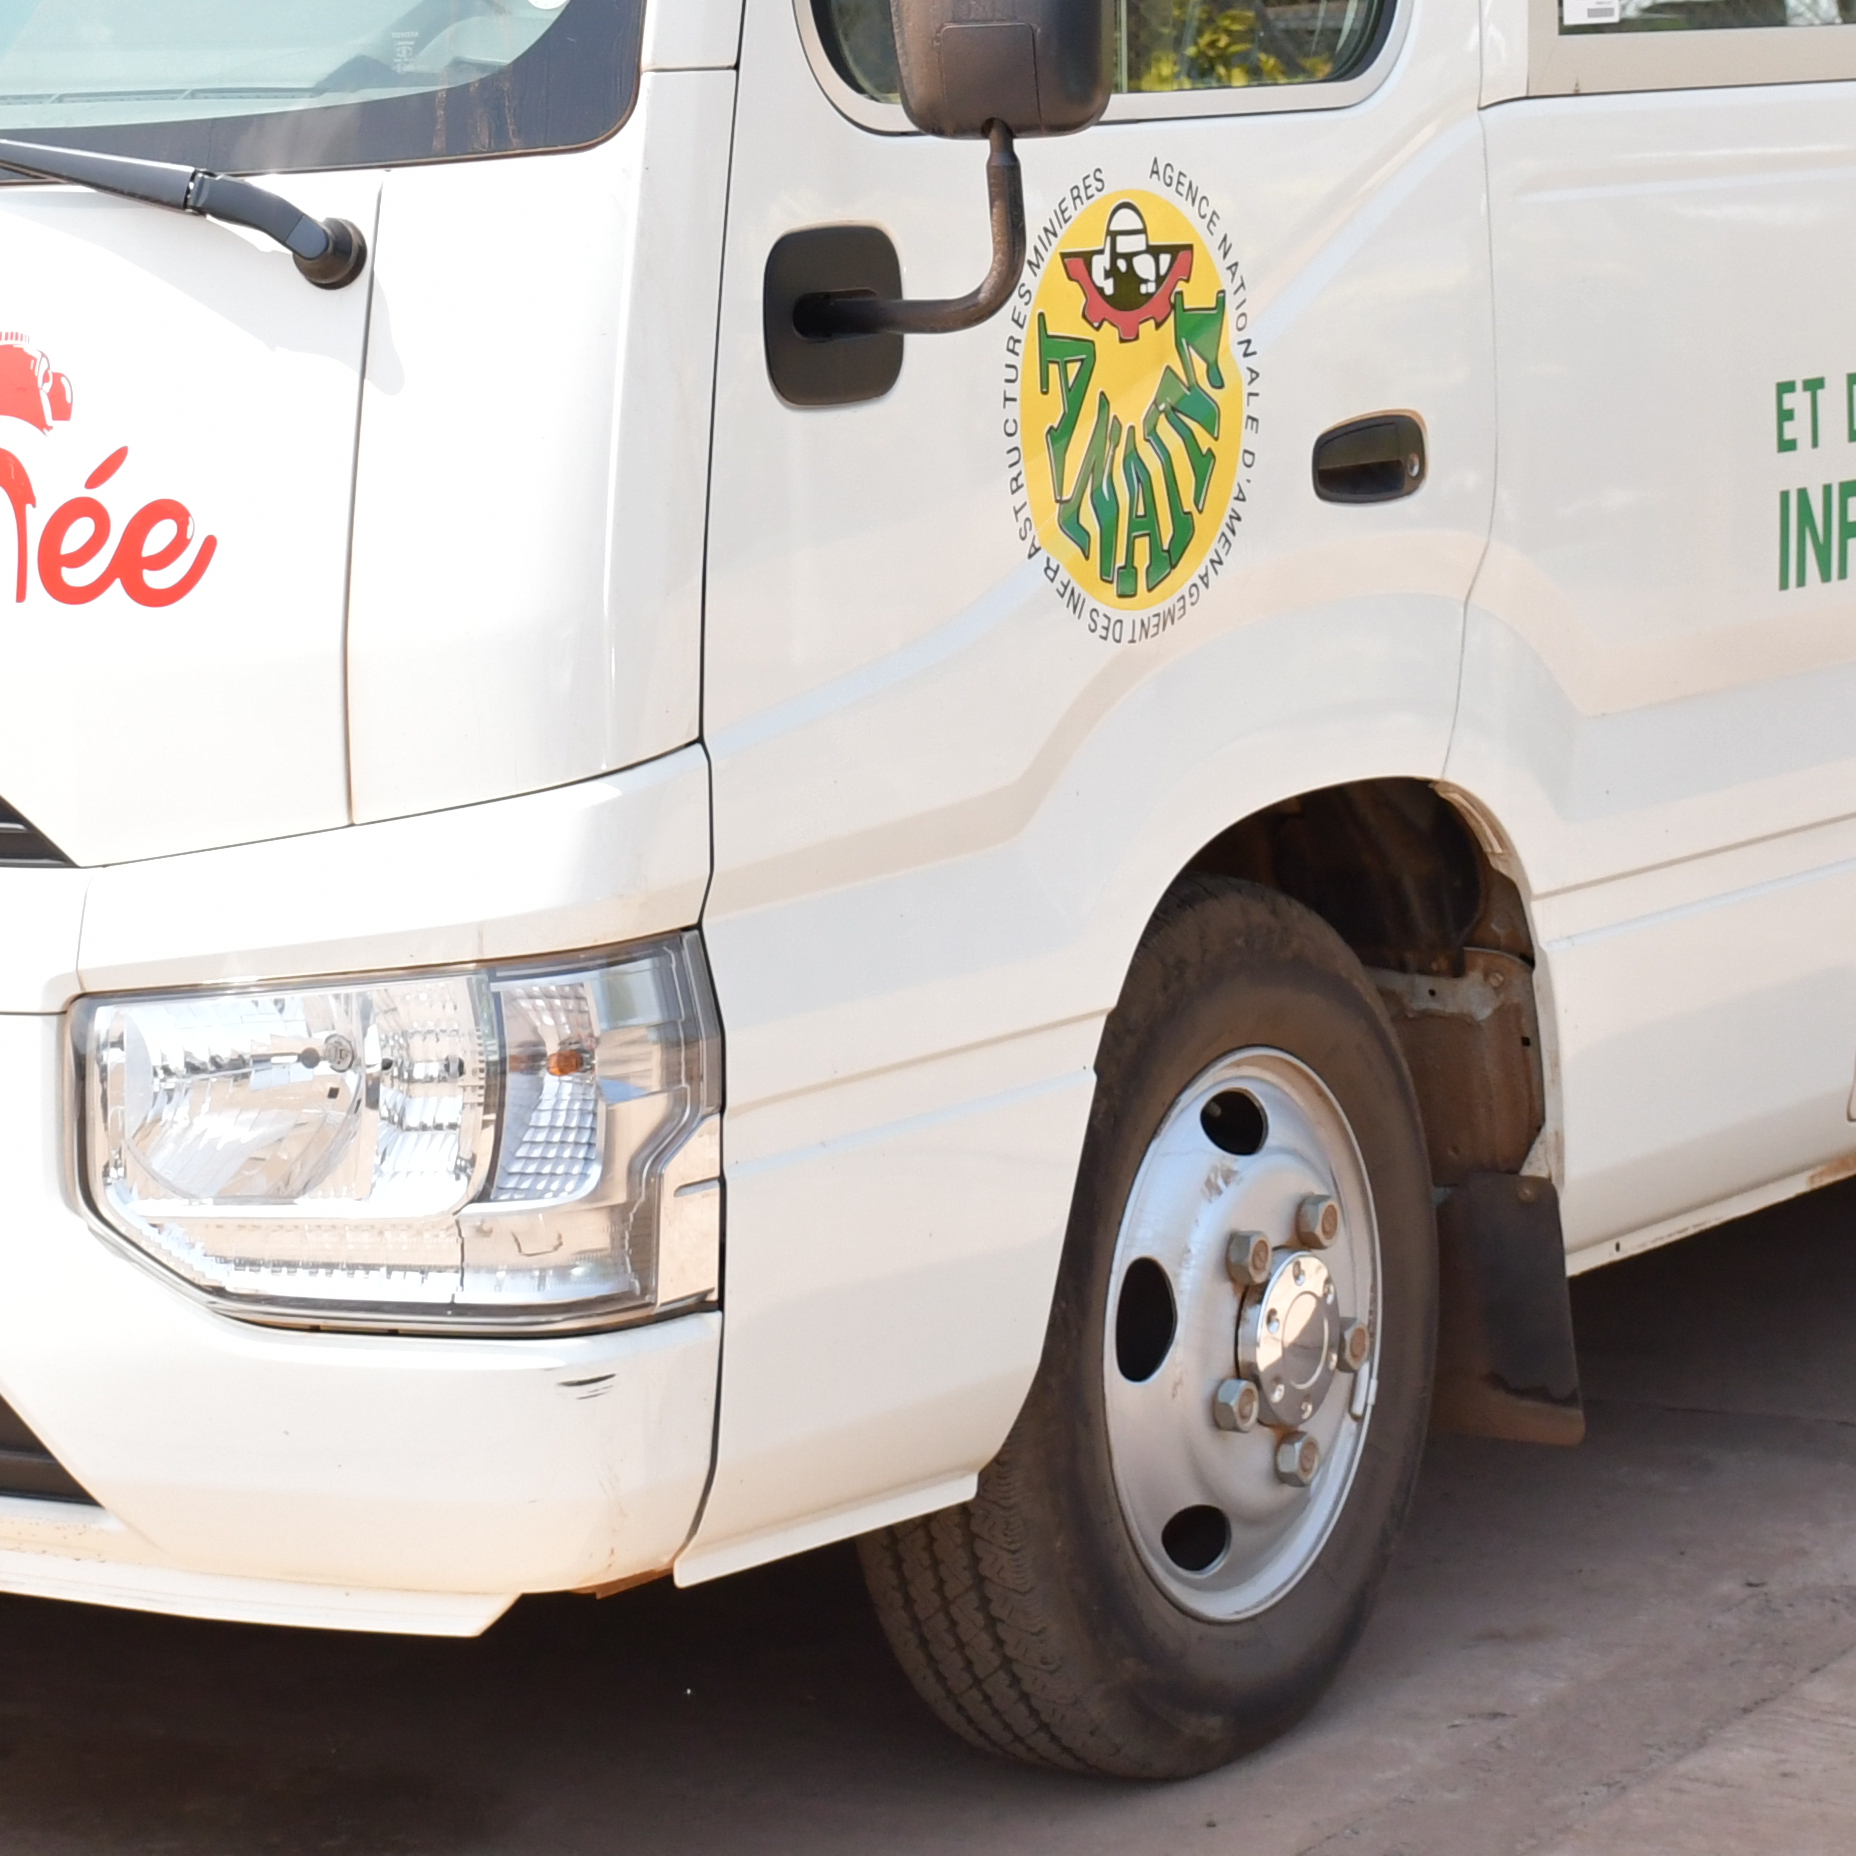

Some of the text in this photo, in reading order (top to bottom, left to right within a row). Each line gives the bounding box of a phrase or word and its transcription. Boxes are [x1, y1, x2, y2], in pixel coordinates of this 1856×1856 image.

[1003, 156, 1260, 644] AGENCE NATIONALE D'AMENAGEMENT DES INFRASTRUCTURES MINIERES
[1776, 376, 1826, 453] ET
